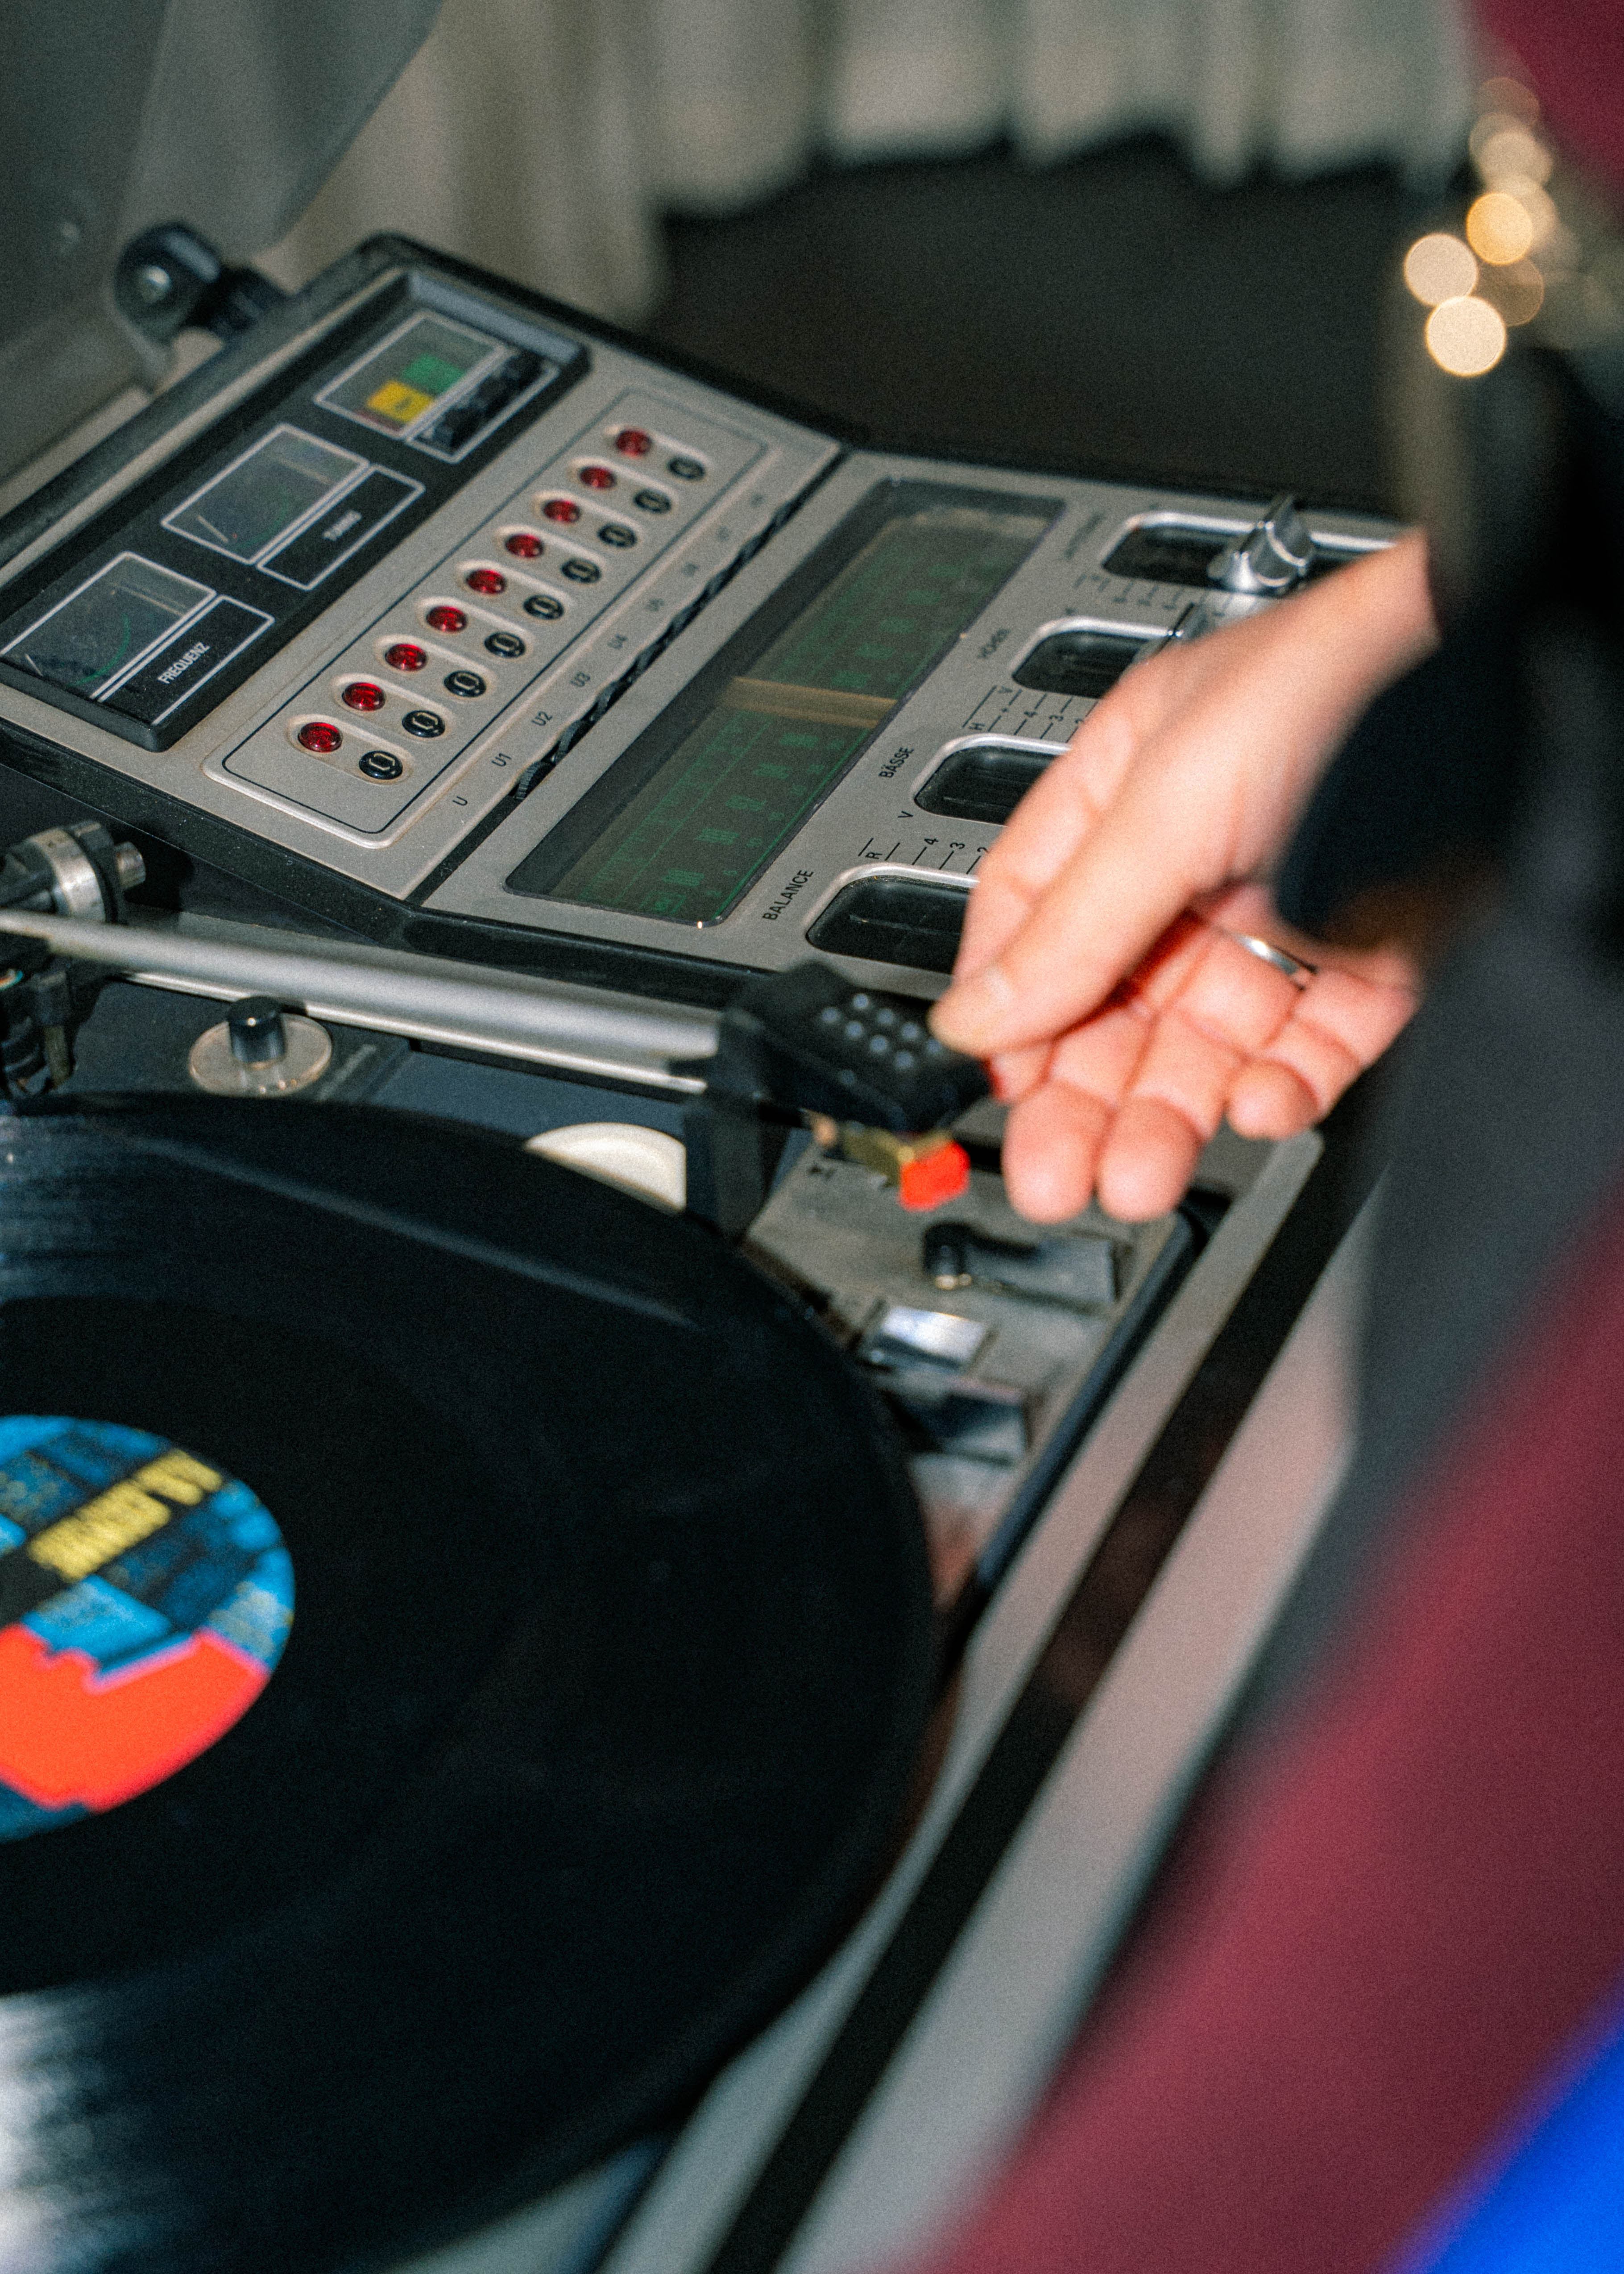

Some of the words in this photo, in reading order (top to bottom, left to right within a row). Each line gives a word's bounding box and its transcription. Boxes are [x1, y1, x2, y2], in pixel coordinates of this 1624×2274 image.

[157, 642, 210, 684] FREQUENZ
[570, 672, 590, 687] U3
[532, 711, 553, 726] U2
[492, 753, 512, 767] U1
[878, 747, 914, 779] BÄSSE
[452, 796, 468, 806] U
[897, 810, 914, 818] V
[762, 870, 815, 921] BALANCE
